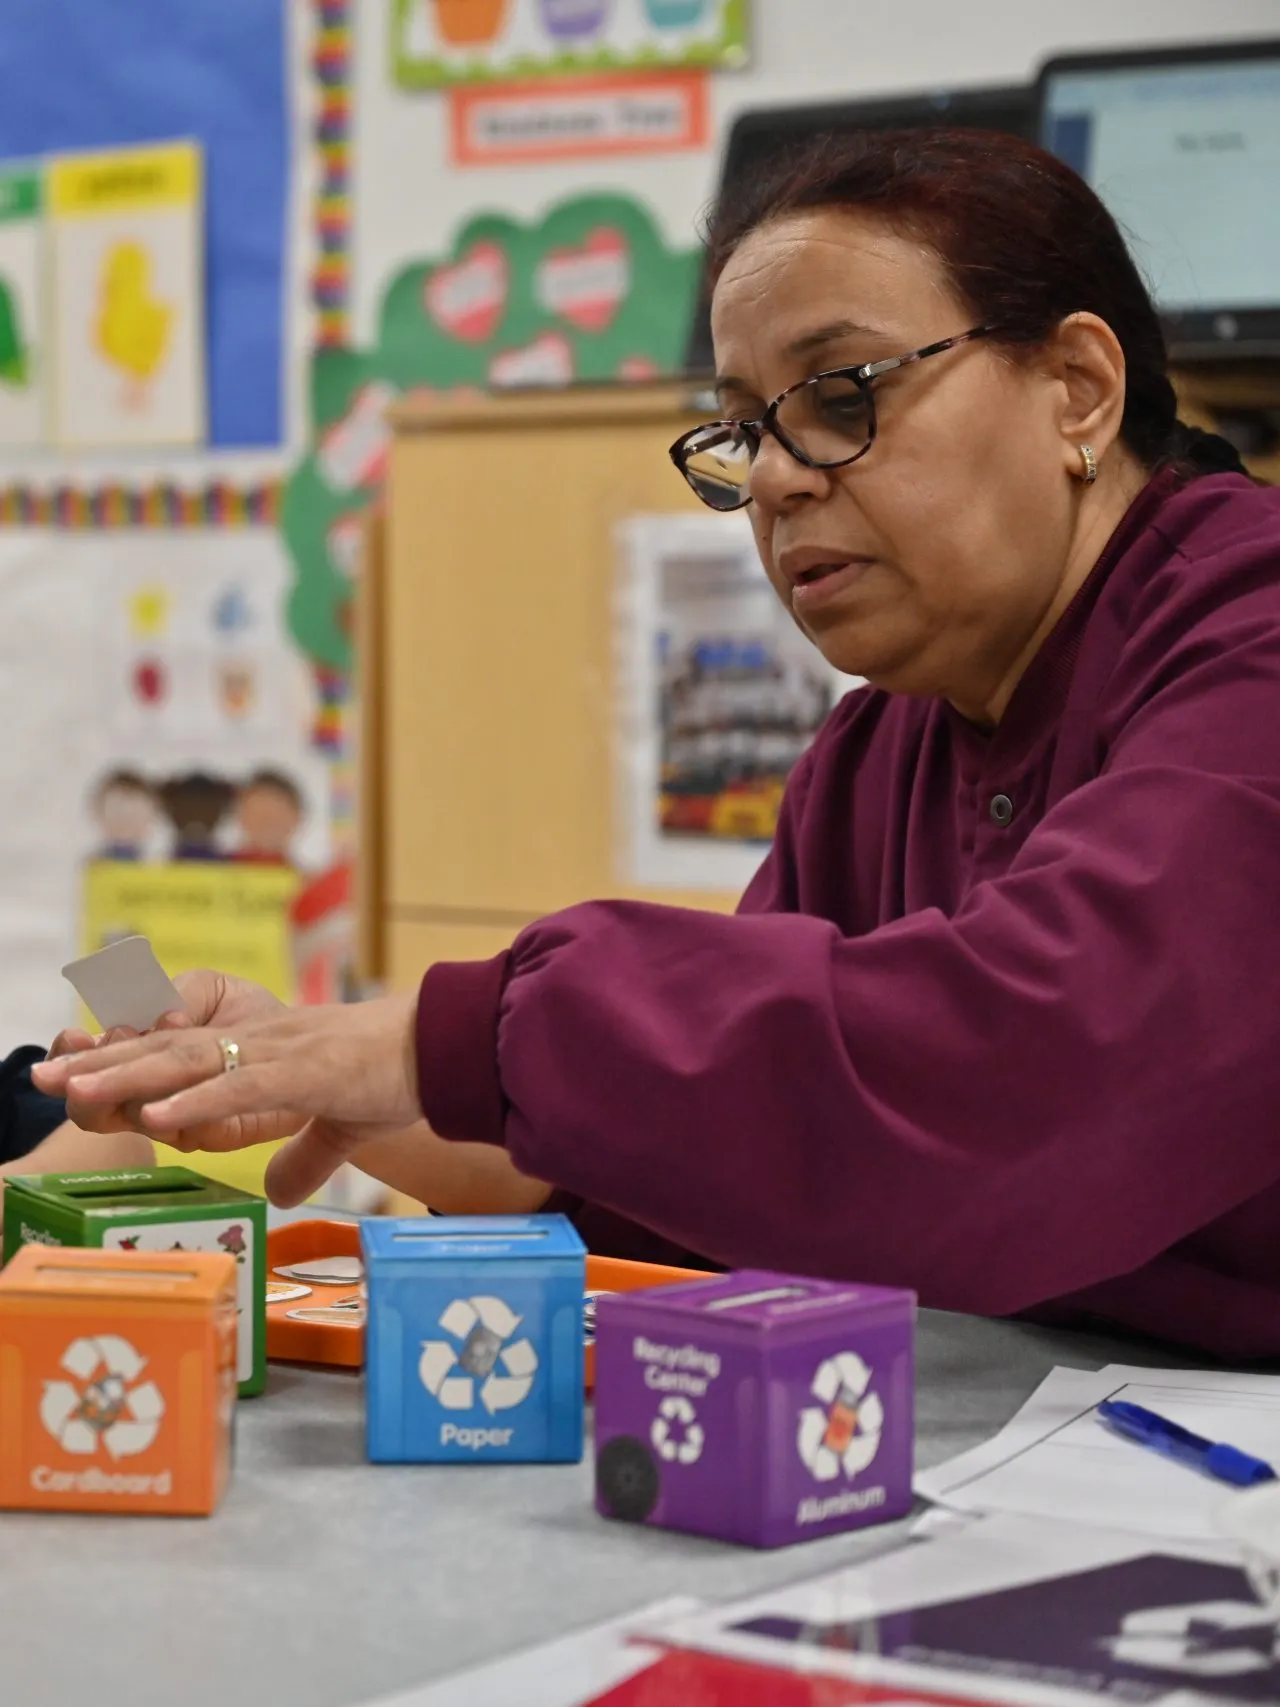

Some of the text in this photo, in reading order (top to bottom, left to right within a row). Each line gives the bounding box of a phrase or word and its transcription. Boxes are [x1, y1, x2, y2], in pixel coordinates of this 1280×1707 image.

[632, 1335, 721, 1380] Recycling
[644, 1364, 708, 1397] Center
[439, 1422, 514, 1451] Paper
[30, 1465, 172, 1496] Cardboard
[795, 1486, 886, 1528] Aluminum
